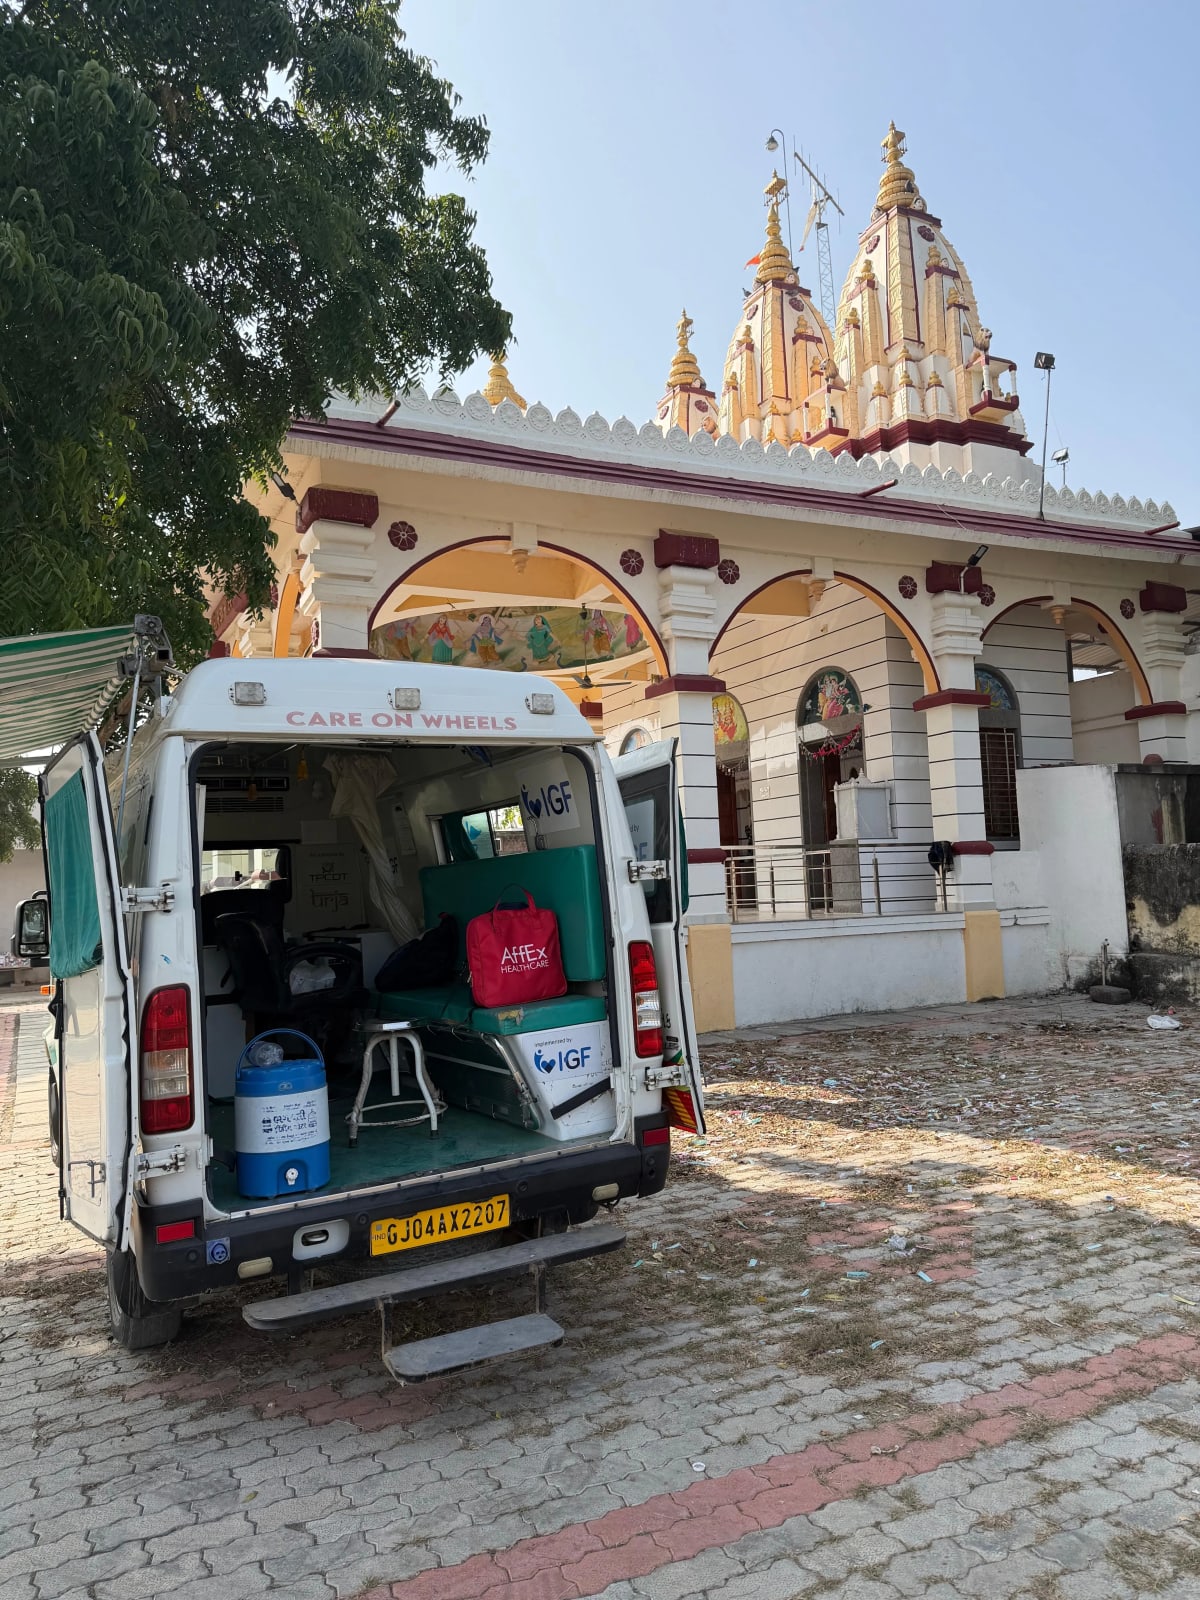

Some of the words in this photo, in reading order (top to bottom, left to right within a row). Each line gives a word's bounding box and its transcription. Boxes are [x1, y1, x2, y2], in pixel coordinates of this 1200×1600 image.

[286, 711, 362, 727] CARE
[371, 712, 413, 728] ON
[420, 713, 518, 731] WHEELS
[541, 780, 572, 817] IGF
[501, 944, 548, 965] AffEx
[501, 960, 549, 974] HEALTHCARE
[558, 1046, 592, 1072] IGF
[387, 1199, 506, 1245] GJ04AX2207
